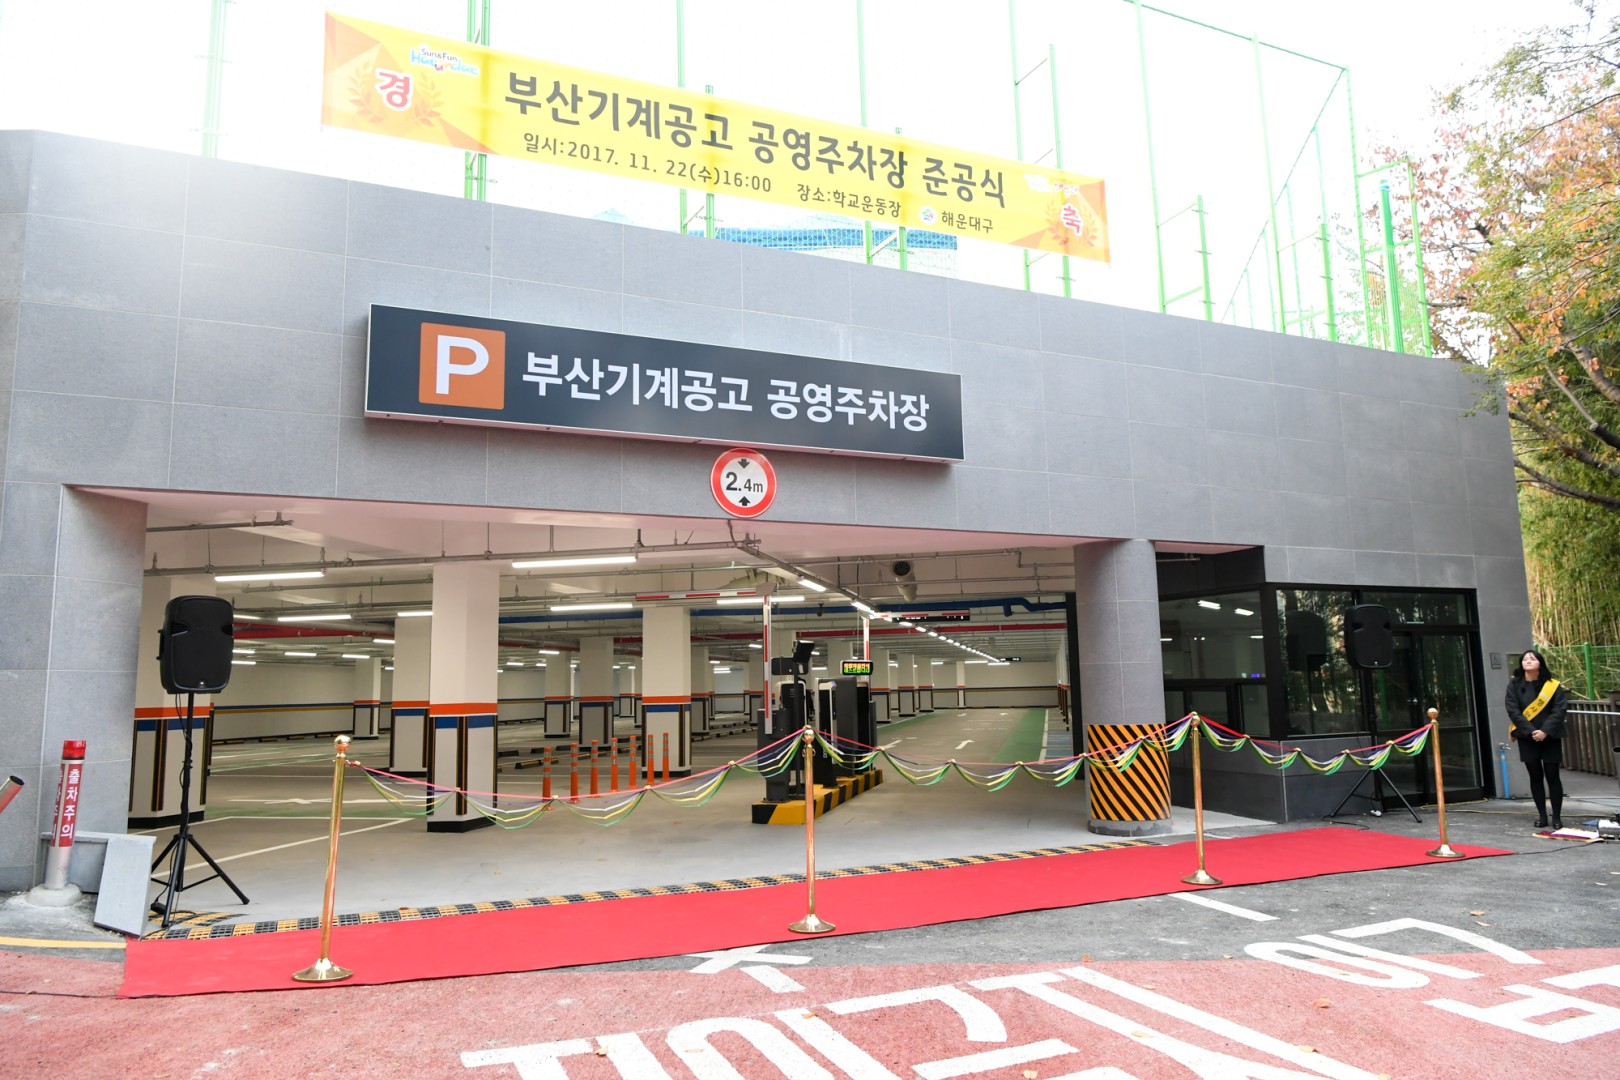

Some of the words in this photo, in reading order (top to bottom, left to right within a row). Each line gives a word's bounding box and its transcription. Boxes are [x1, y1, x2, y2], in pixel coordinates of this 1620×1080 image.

[421, 48, 458, 62] Sun&Fun
[378, 72, 411, 107] 경
[505, 71, 734, 150] 부산기계공고
[748, 120, 908, 189] 공영주차장
[922, 157, 1005, 208] 준공식
[797, 183, 902, 218] 장소:학교운동장
[941, 210, 994, 234] 해운대구
[1062, 205, 1082, 234] 축
[435, 334, 491, 396] P
[521, 352, 754, 414] 부산기계공고
[766, 378, 931, 433] 공영주차장
[725, 471, 764, 493] 2.4m
[59, 768, 81, 840] 출차주의
